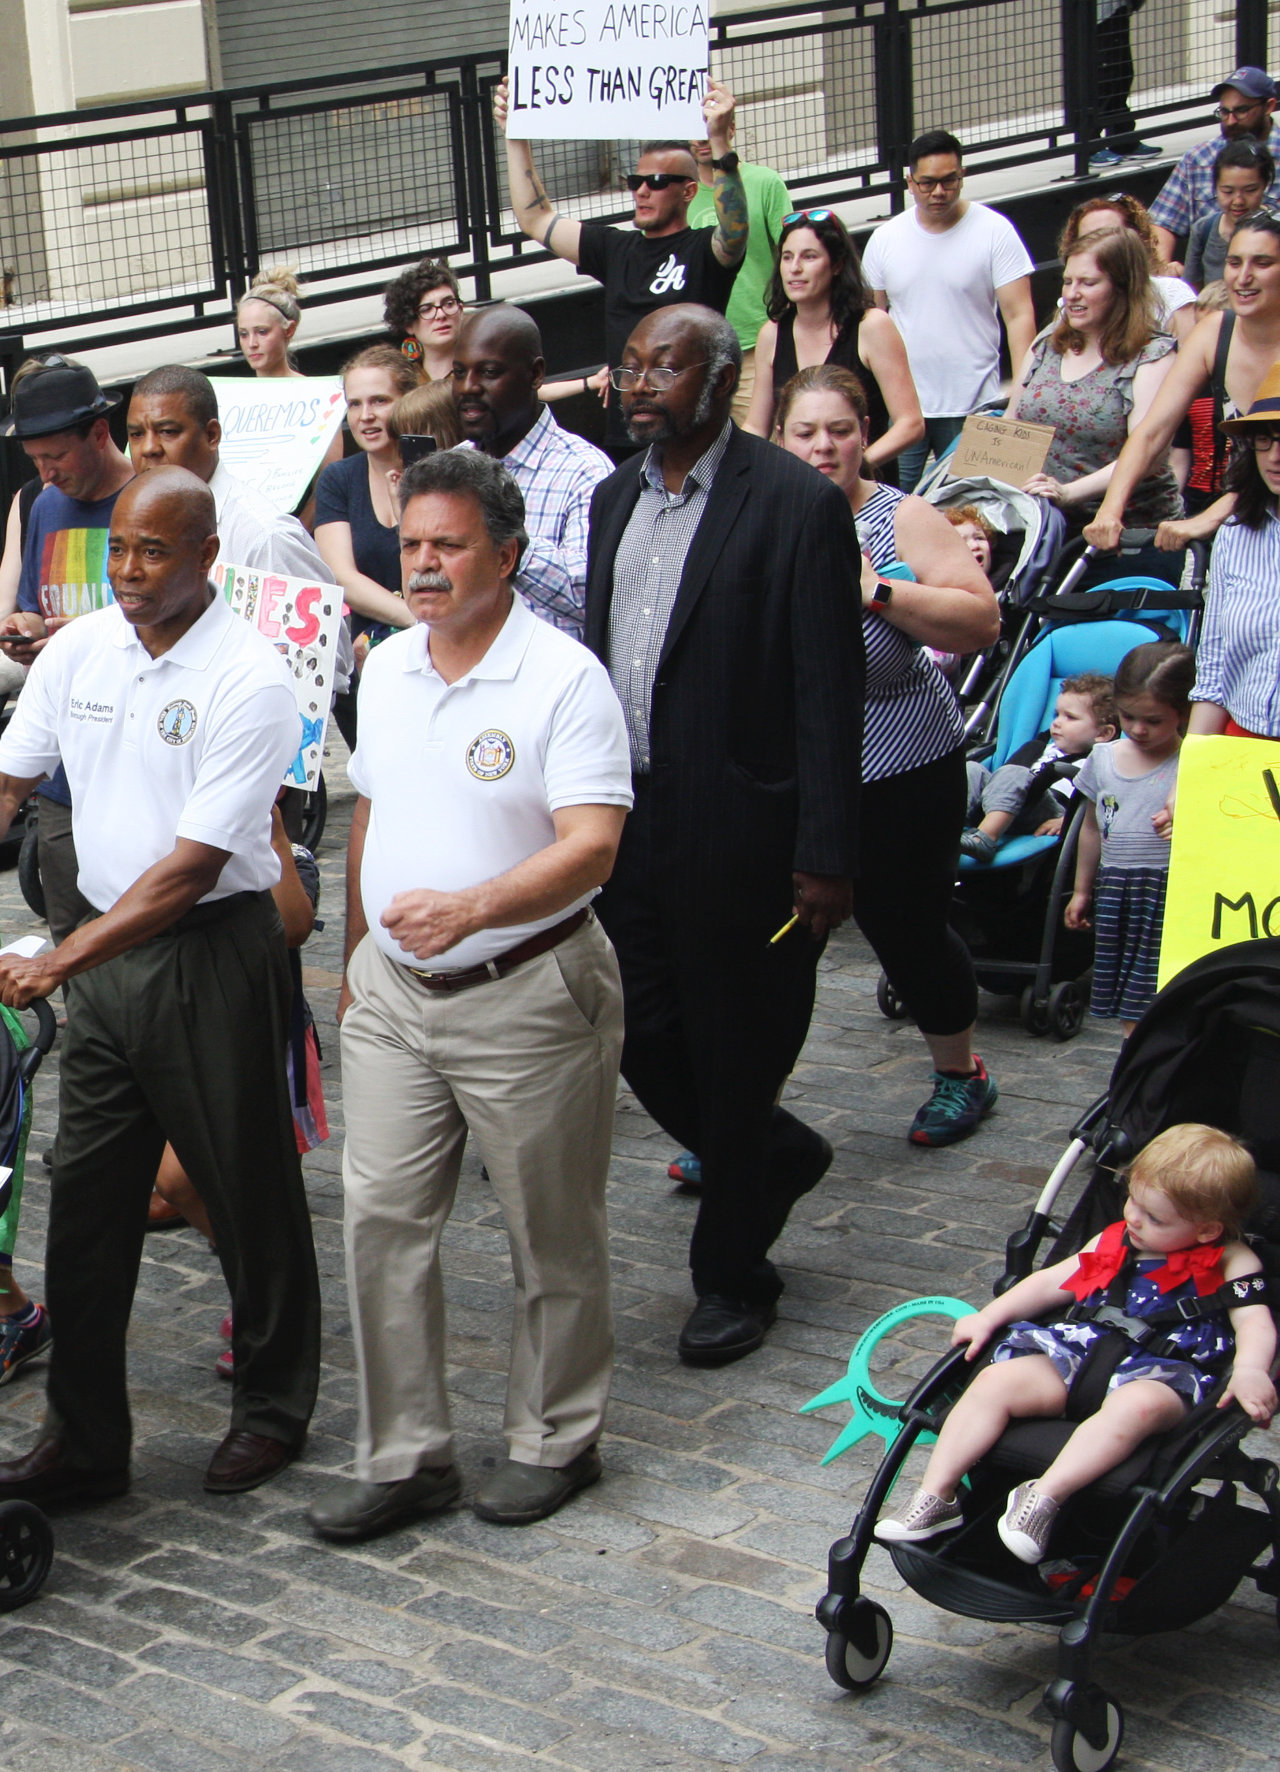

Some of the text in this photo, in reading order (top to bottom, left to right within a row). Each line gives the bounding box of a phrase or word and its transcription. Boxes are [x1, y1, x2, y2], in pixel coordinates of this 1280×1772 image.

[510, 3, 707, 54] MAKES AMERICA
[513, 65, 708, 112] LESS THAN GREAT
[223, 397, 321, 440] QUEREMOS
[84, 700, 114, 714] Adams
